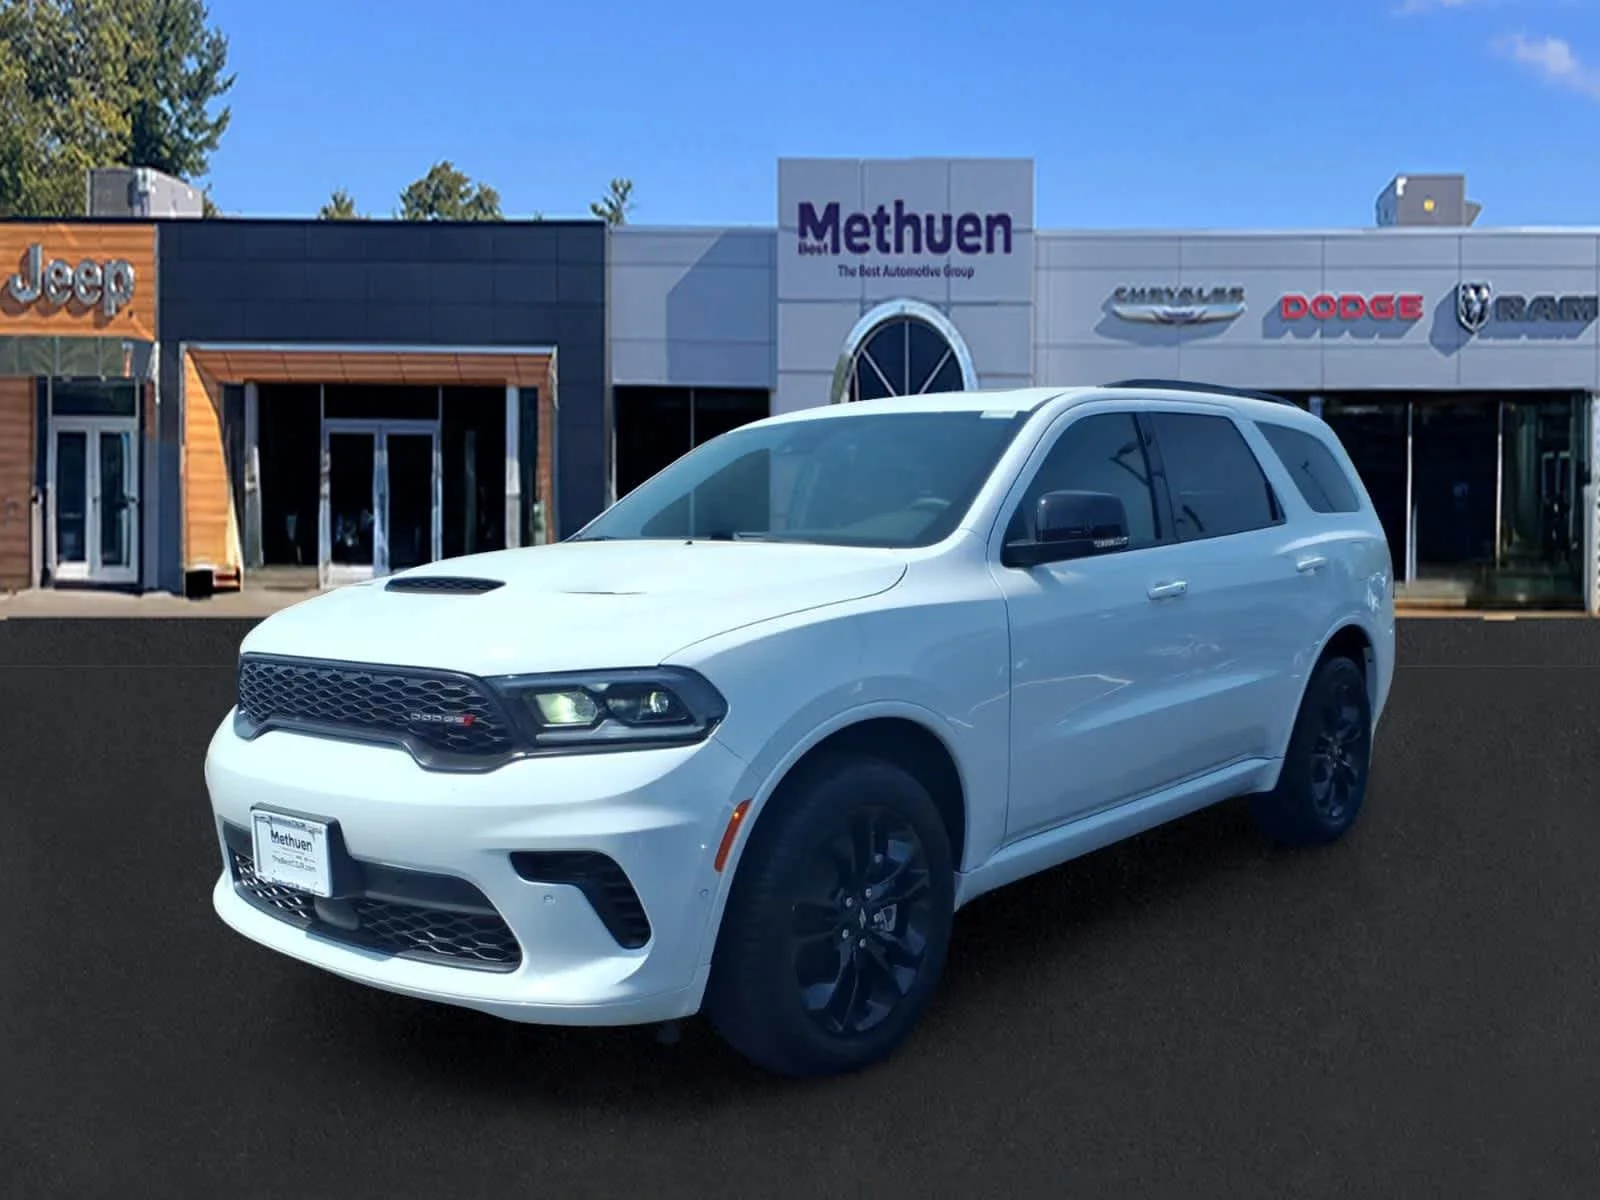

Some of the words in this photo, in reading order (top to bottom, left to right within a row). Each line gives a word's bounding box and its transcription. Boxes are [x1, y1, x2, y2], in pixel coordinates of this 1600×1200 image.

[798, 200, 1012, 255] Methuen
[798, 241, 829, 256] Best
[8, 242, 135, 317] Jeep
[838, 264, 857, 277] The
[859, 264, 880, 277] Best
[883, 264, 940, 277] Automotive
[943, 264, 975, 279] Group
[1113, 286, 1245, 303] CHRYSLER
[1281, 294, 1424, 320] DODGE
[1495, 295, 1599, 322] RAM
[271, 829, 313, 853] Methuen
